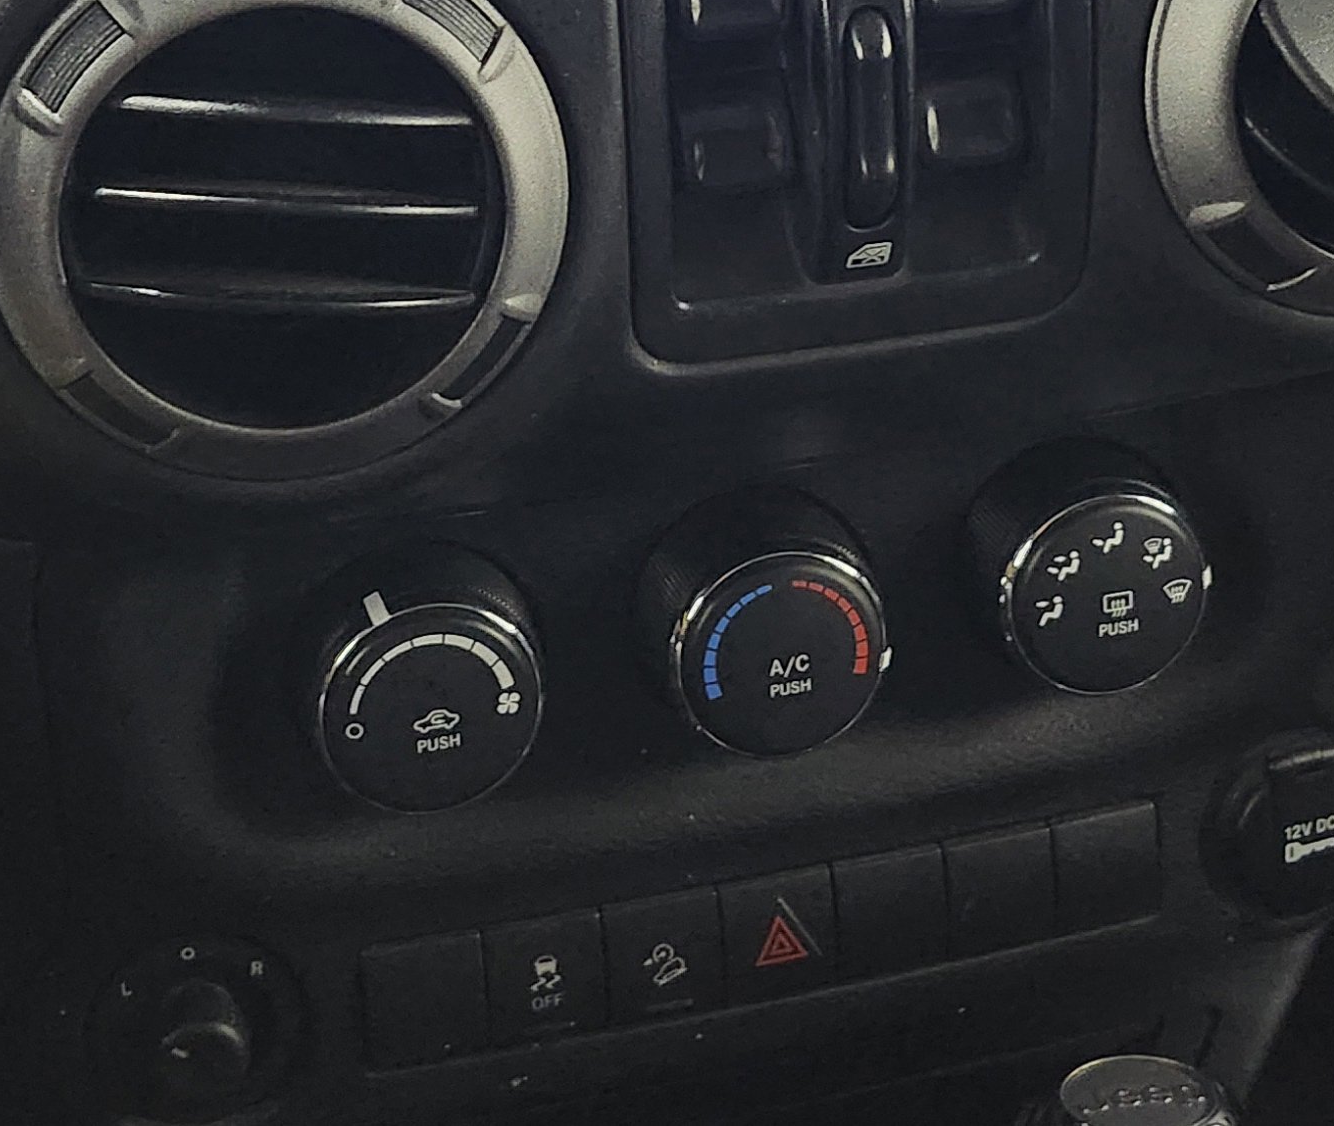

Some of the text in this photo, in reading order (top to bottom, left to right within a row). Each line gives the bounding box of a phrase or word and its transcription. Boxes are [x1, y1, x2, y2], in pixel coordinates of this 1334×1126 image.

[1098, 618, 1140, 638] PUSH
[768, 652, 811, 678] A/C
[769, 677, 813, 699] PUSH
[416, 732, 462, 754] PUSH
[1284, 820, 1313, 840] 12V
[250, 960, 263, 976] R
[120, 982, 133, 997] L
[531, 992, 564, 1011] OFF
